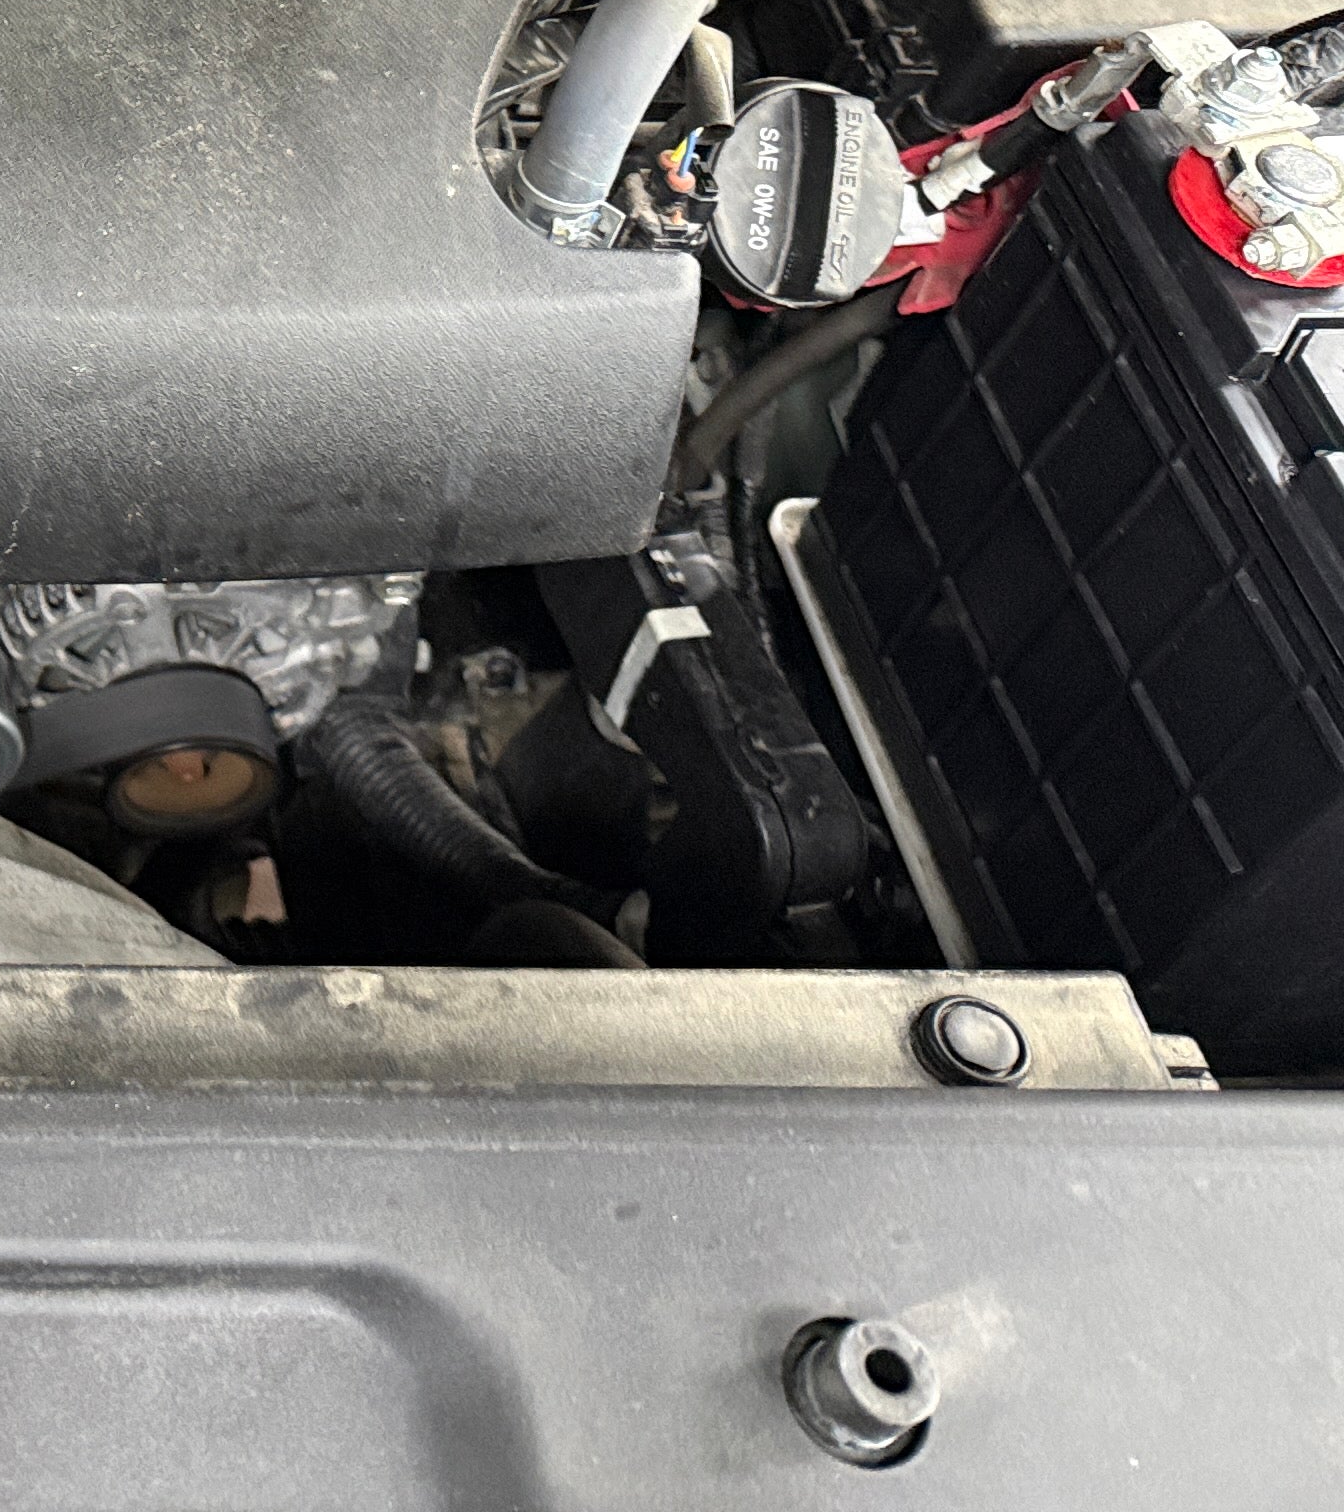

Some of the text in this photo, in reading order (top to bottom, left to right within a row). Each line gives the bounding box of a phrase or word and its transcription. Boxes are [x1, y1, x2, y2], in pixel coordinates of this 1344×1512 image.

[747, 126, 781, 252] SAE 0W-20
[834, 109, 863, 223] ENGINE OIL
